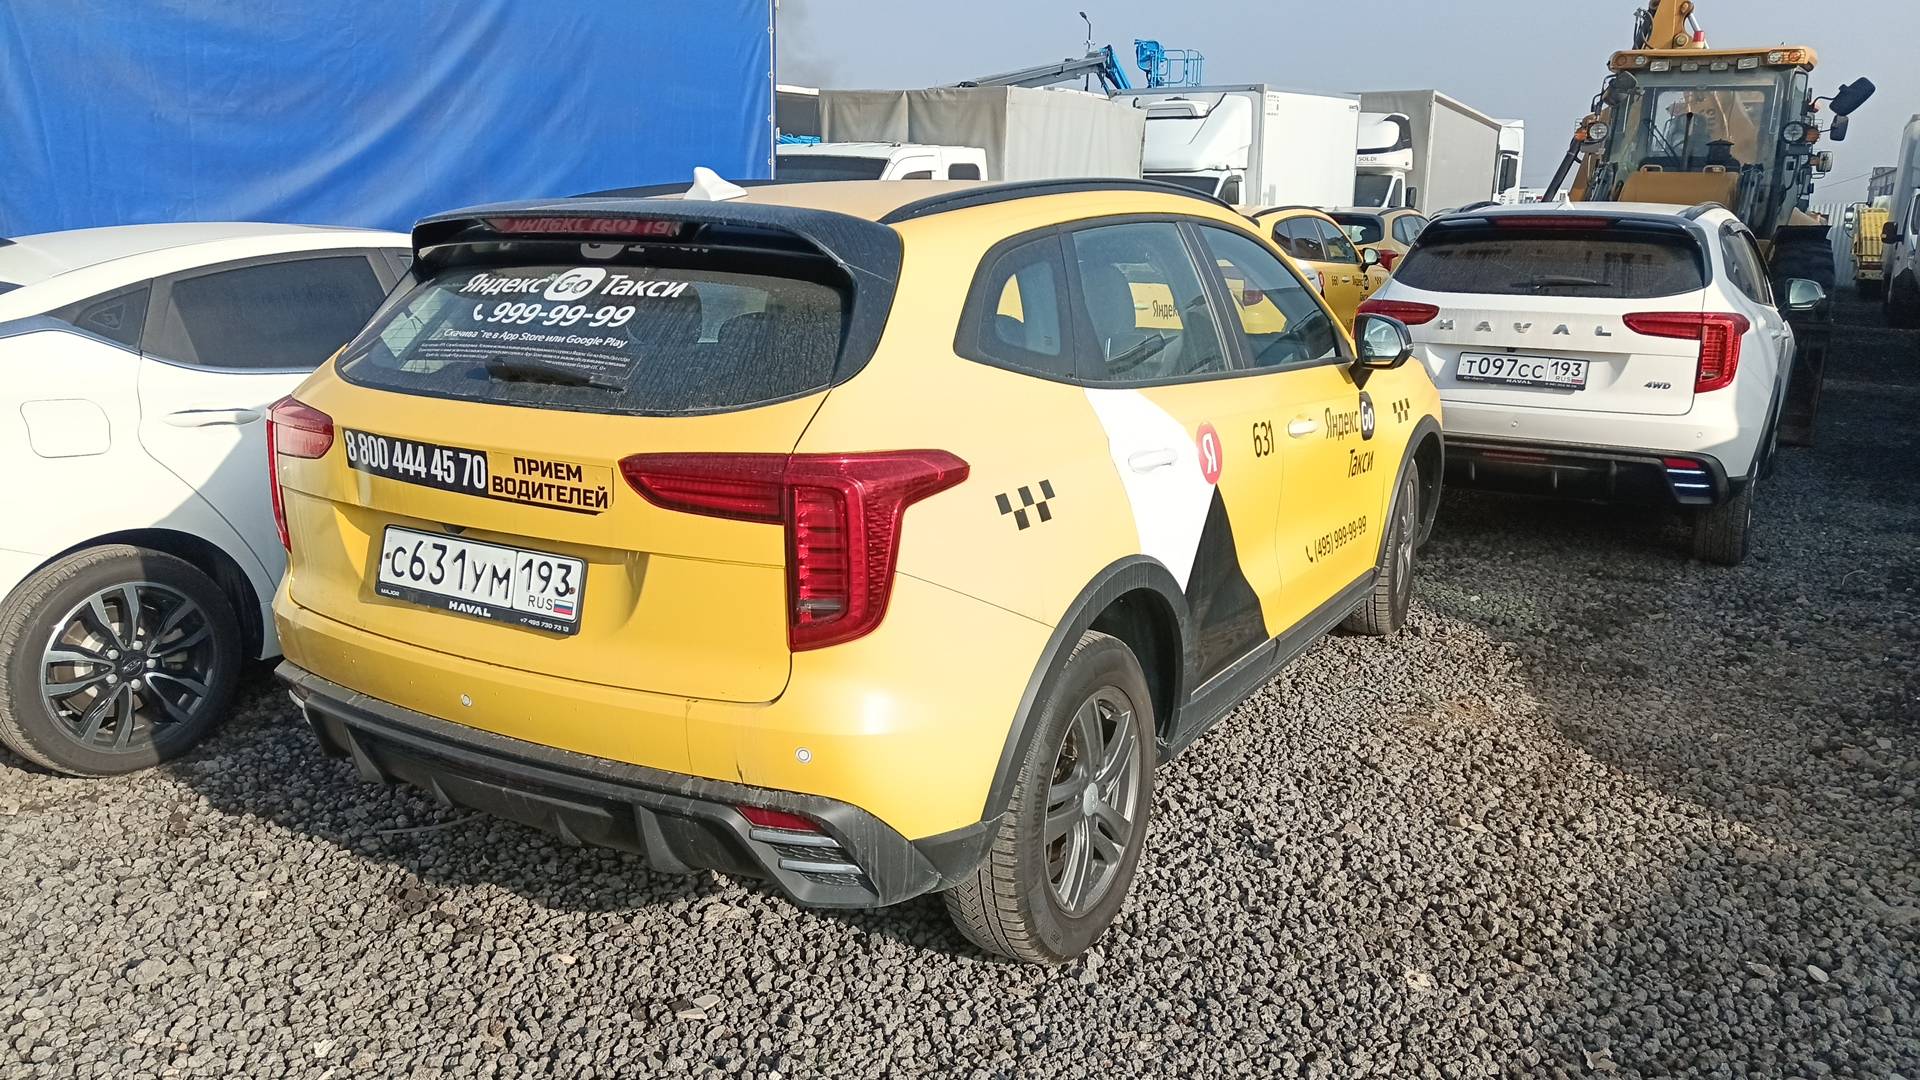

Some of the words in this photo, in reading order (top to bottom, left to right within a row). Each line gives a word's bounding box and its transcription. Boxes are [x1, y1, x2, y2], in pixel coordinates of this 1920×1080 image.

[459, 273, 550, 296] Яндекс
[553, 273, 593, 294] Go
[600, 275, 689, 298] Такси
[487, 302, 636, 327] 999-99-99
[444, 328, 492, 338] Скачивате
[499, 331, 519, 341] App
[519, 333, 545, 343] Store
[566, 335, 602, 347] Google
[603, 338, 629, 349] Play
[1439, 319, 1612, 337] HAVAL
[1551, 361, 1582, 376] 193
[1644, 381, 1671, 390] 4WD
[1325, 407, 1359, 441] Яндекс
[1361, 401, 1374, 431] Go
[1252, 419, 1275, 458] 631
[345, 430, 357, 462] 8
[358, 434, 389, 470] 800
[392, 441, 427, 479] 444
[430, 448, 455, 484] 45
[459, 452, 486, 489] 70
[1202, 431, 1218, 474] Я
[1348, 448, 1374, 479] Такси
[513, 456, 583, 483] ПРИЕМ
[492, 475, 608, 509] ВОДИТЕЛЕЙ
[1315, 532, 1334, 563] (495)
[1334, 515, 1367, 549] 999-99-99
[521, 558, 572, 597] 193
[380, 588, 400, 596] MAJOR
[528, 594, 553, 611] RUS
[448, 601, 492, 618] HAVAL
